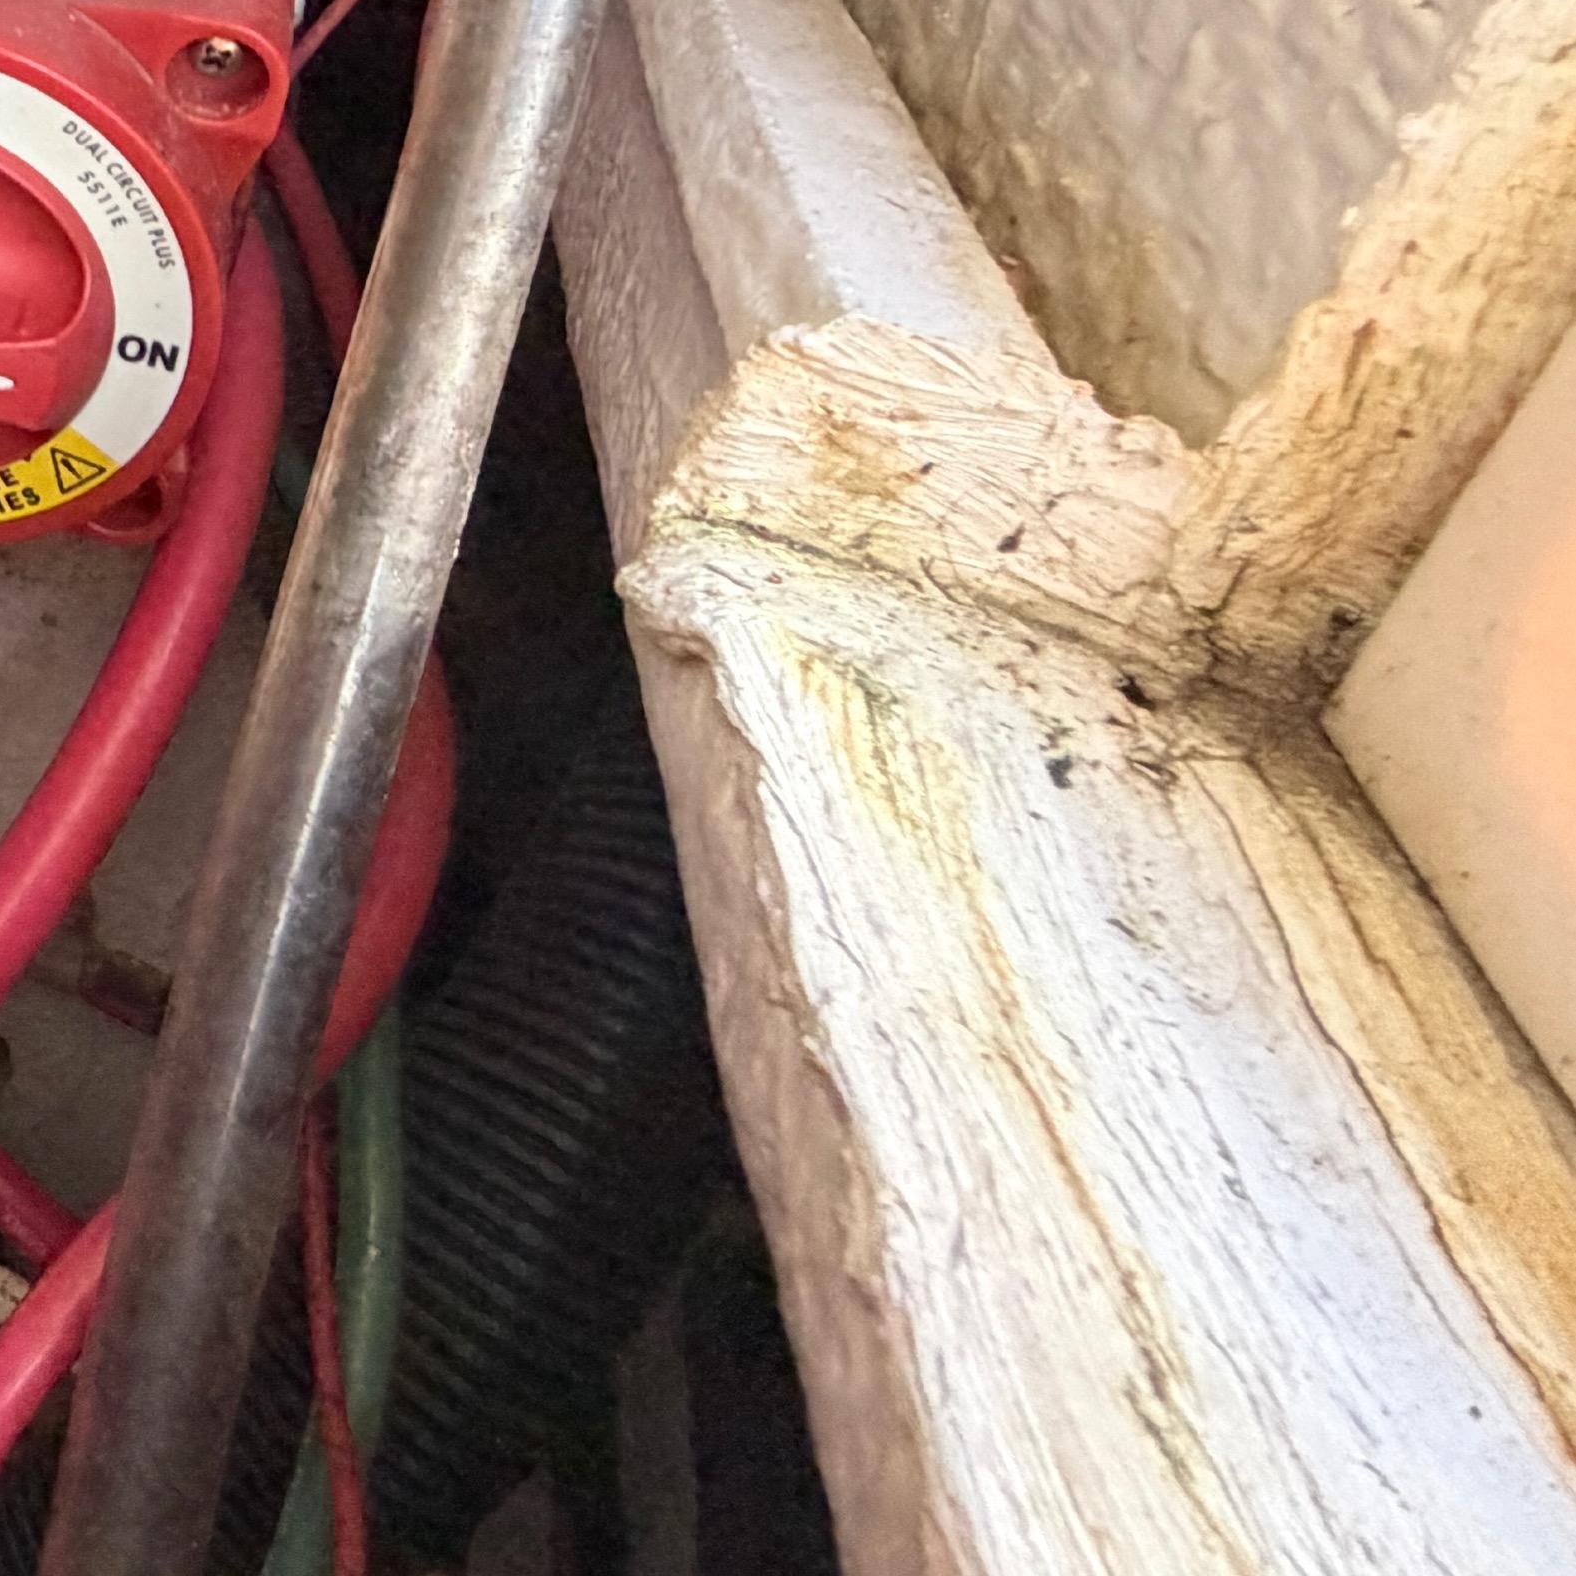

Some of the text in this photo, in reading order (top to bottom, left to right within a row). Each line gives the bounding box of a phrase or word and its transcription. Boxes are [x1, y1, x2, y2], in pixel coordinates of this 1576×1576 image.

[62, 120, 176, 270] DUAL CIRCUIT PLUS
[77, 170, 128, 228] 5511E
[117, 335, 179, 372] ON
